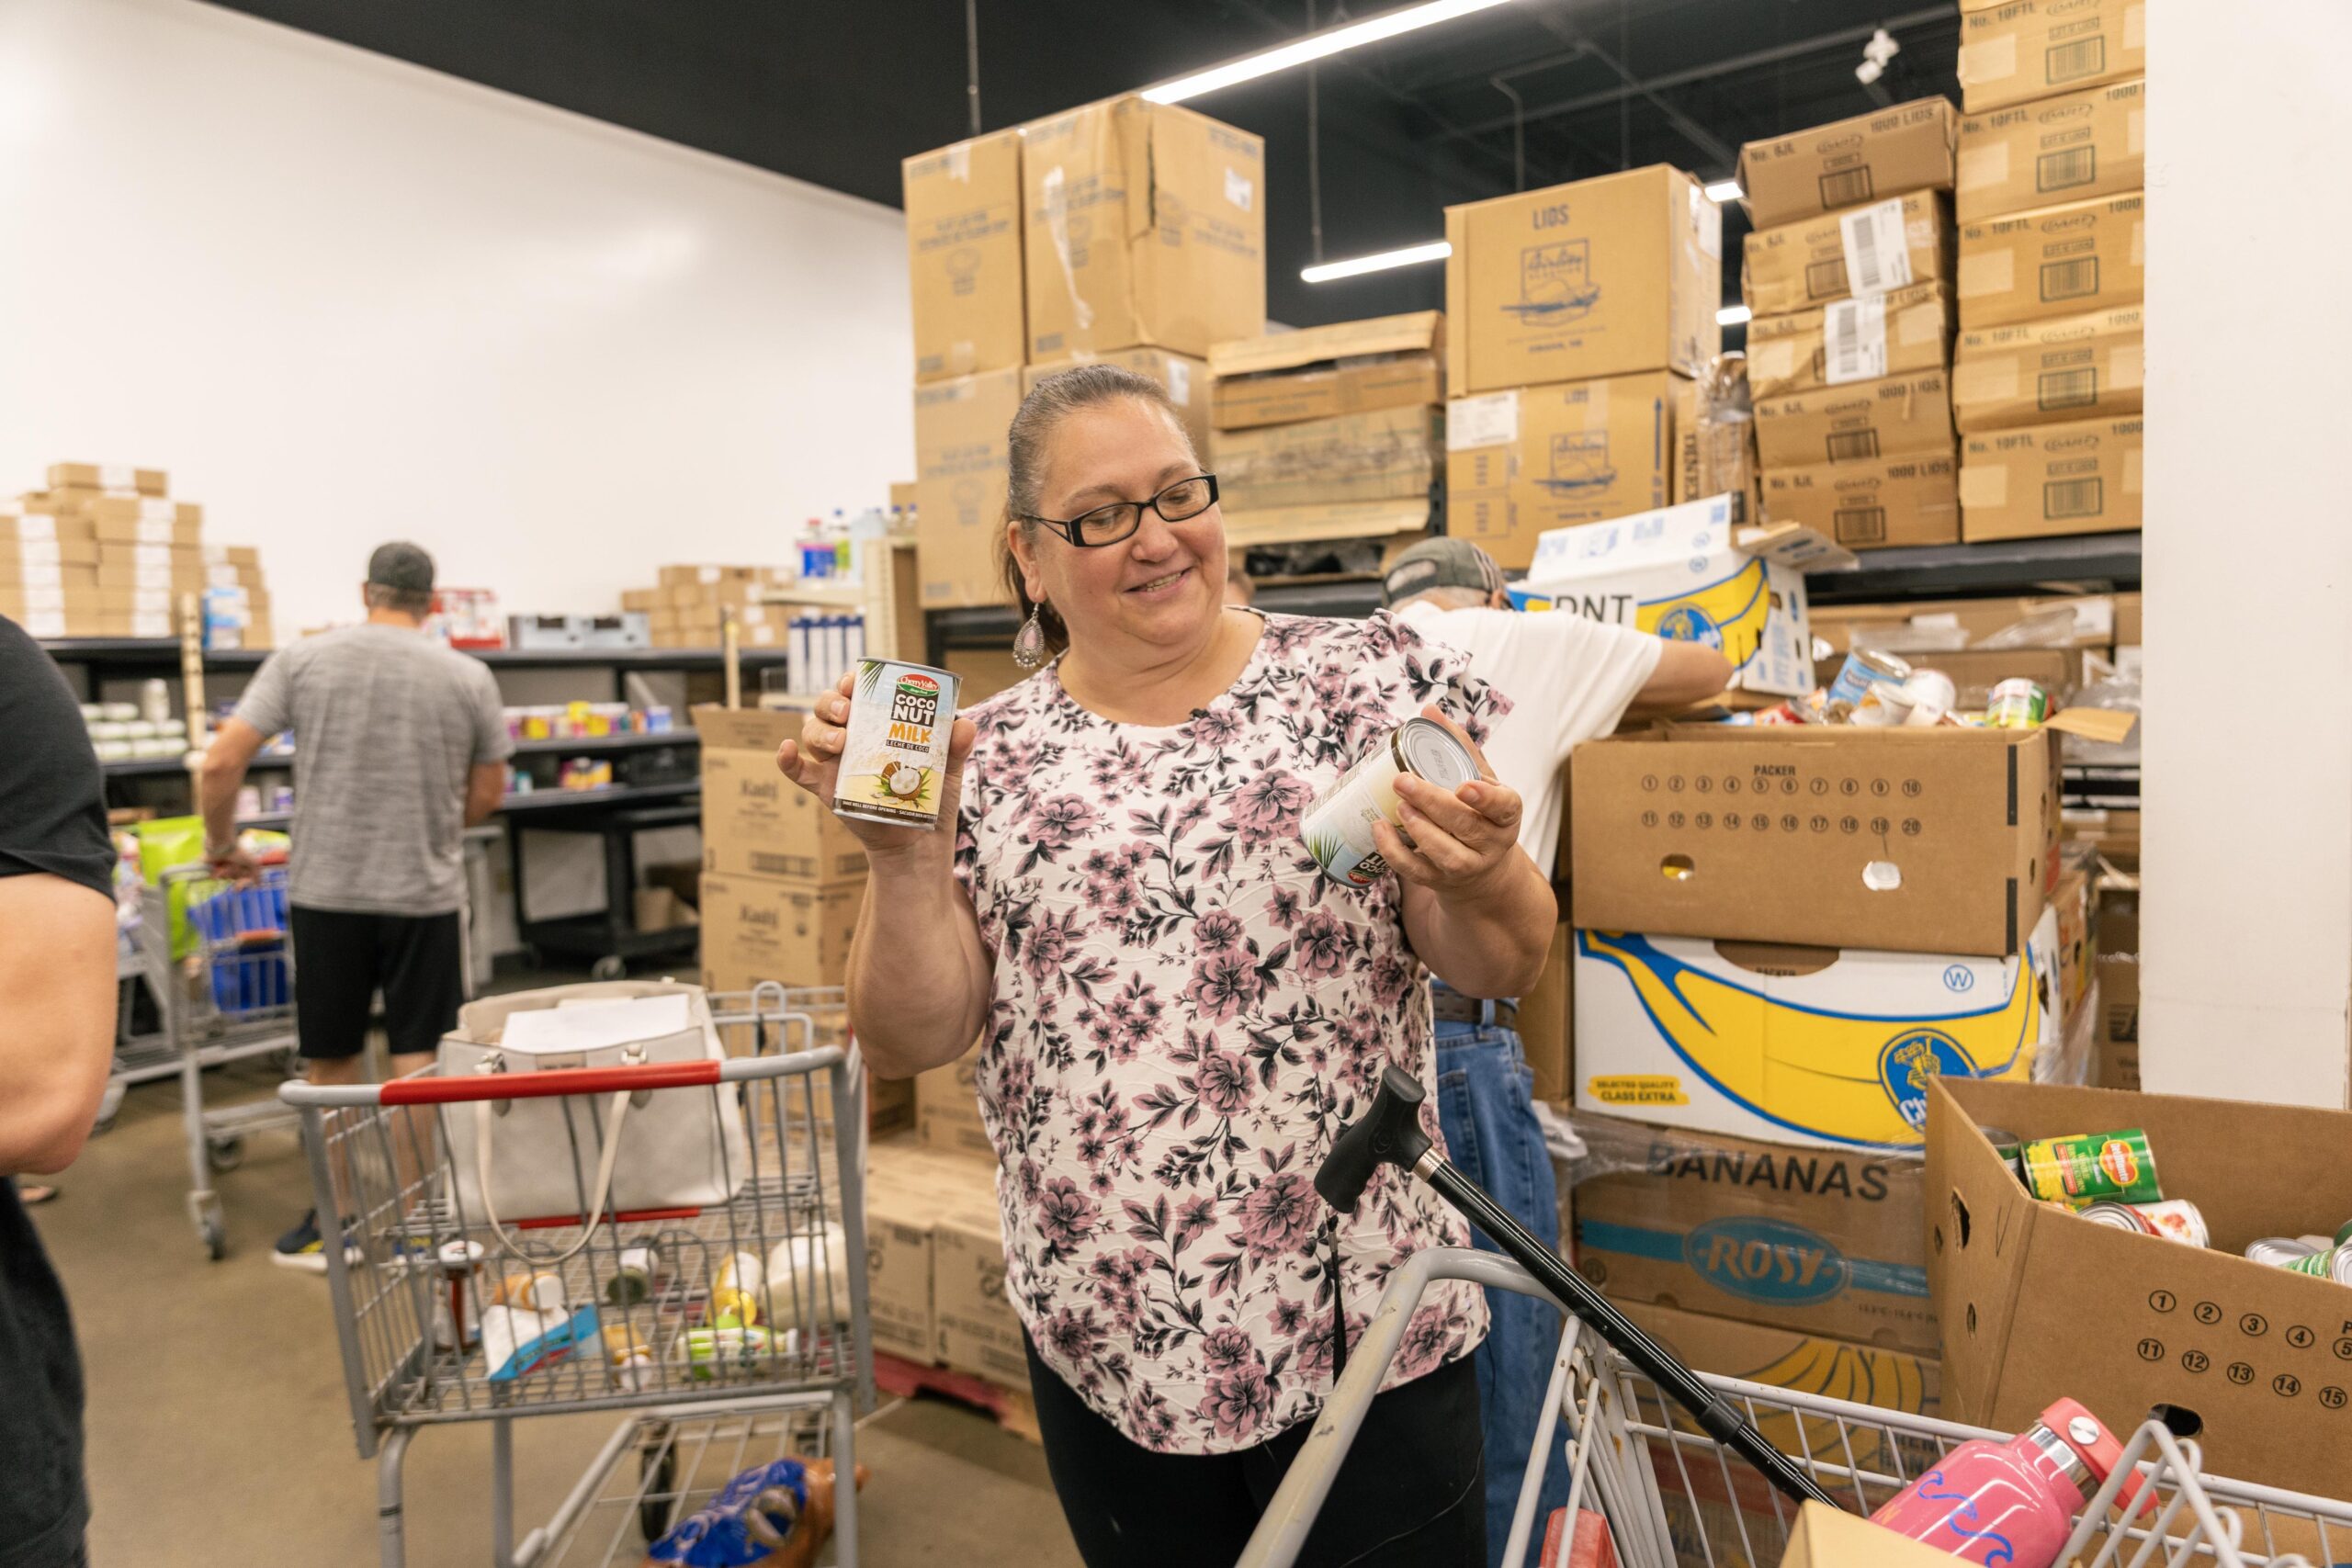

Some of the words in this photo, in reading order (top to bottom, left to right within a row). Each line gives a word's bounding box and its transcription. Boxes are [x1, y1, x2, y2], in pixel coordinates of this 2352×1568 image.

[1532, 204, 1570, 230] LIDS
[896, 694, 936, 710] COCO
[893, 706, 934, 726] NUT
[888, 723, 933, 744] MILK
[887, 739, 905, 749] LECHE
[915, 744, 930, 752] COCO
[1754, 765, 1796, 776] PACKER
[1597, 1080, 1636, 1090] SELECTED
[1638, 1081, 1675, 1091] QUALITY
[1600, 1090, 1633, 1101] CLASS
[1635, 1091, 1676, 1102] EXTRA
[1647, 1140, 1889, 1201] BANANAS
[1707, 1235, 1826, 1287] ROSY
